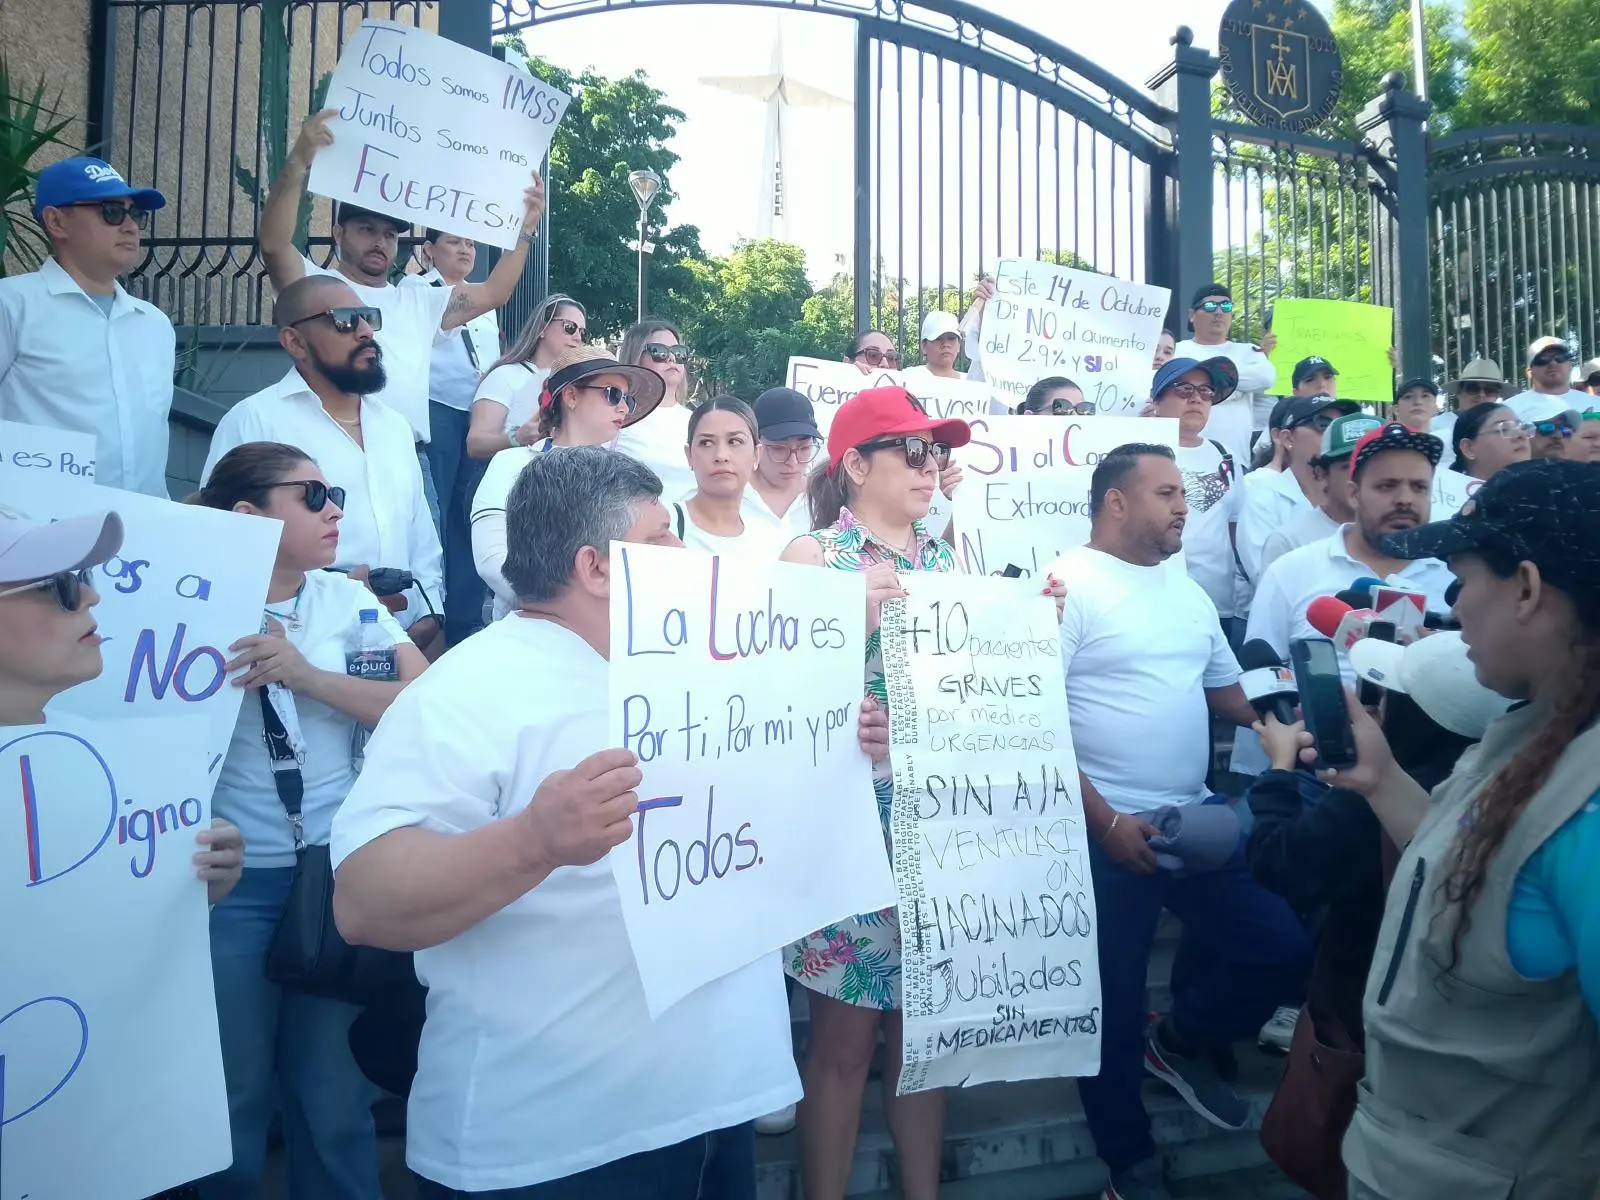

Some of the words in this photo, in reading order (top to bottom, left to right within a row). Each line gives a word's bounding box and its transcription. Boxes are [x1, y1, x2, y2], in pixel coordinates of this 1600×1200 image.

[361, 25, 432, 87] Todos
[502, 75, 560, 125] IMSS
[340, 86, 422, 143] Juntos
[500, 150, 528, 167] mas
[353, 143, 519, 231] FUERTES!!
[995, 260, 1039, 296] Este
[1046, 275, 1072, 307] 14
[1071, 290, 1090, 311] de
[1101, 286, 1162, 318] Octubre
[1026, 308, 1057, 340] NO
[1062, 321, 1076, 341] al
[1081, 329, 1146, 351] aumento
[986, 333, 1010, 354] del
[1017, 339, 1066, 367] 2.9%
[1083, 355, 1103, 373] SI
[1104, 356, 1118, 371] al
[12, 451, 52, 468] es
[1033, 439, 1053, 468] al
[176, 574, 212, 601] a
[622, 547, 688, 657] La
[709, 555, 799, 661] Lucha
[811, 617, 846, 649] es
[900, 600, 969, 656] +10
[969, 626, 1059, 686] pacientes
[123, 622, 228, 703] NO
[938, 674, 1043, 704] GRAVES
[624, 694, 668, 762] Por
[727, 694, 754, 753] Por
[765, 705, 793, 745] mi
[826, 702, 852, 752] por
[897, 715, 905, 732] EST
[927, 707, 960, 735] por
[930, 730, 1056, 753] URGENCIAS
[0, 730, 202, 887] Digno
[918, 774, 993, 819] SIN
[895, 839, 901, 848] IS
[899, 820, 907, 855] VIRGIN
[914, 833, 920, 846] TO
[902, 859, 910, 879] AND
[914, 849, 922, 876] FREE
[1046, 854, 1083, 891] ON
[914, 890, 1091, 951] HACINADOS
[902, 912, 912, 1018] WWW.LACOSTE.COM
[919, 970, 926, 984] OF
[924, 952, 1082, 1014] Jubilados
[912, 994, 919, 1004] IS
[913, 1008, 919, 1017] IT
[992, 1003, 1025, 1026] SIN
[936, 1007, 1099, 1055] MEDICAMENTOS
